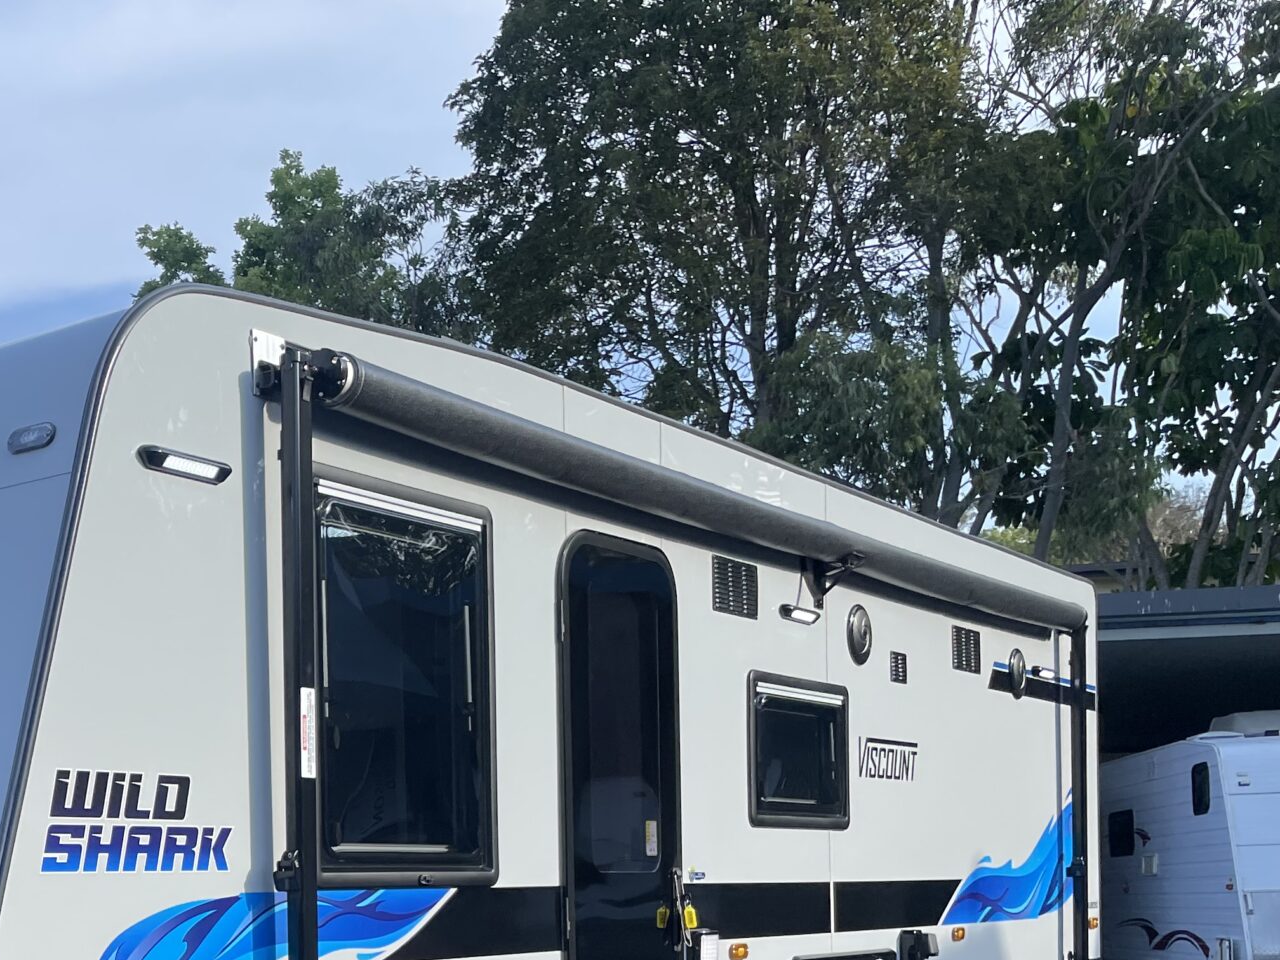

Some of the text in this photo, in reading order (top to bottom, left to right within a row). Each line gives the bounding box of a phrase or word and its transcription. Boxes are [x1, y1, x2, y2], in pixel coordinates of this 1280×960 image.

[858, 735, 918, 781] VISCOUNT
[48, 768, 191, 821] WILD
[39, 824, 235, 874] SHARK
